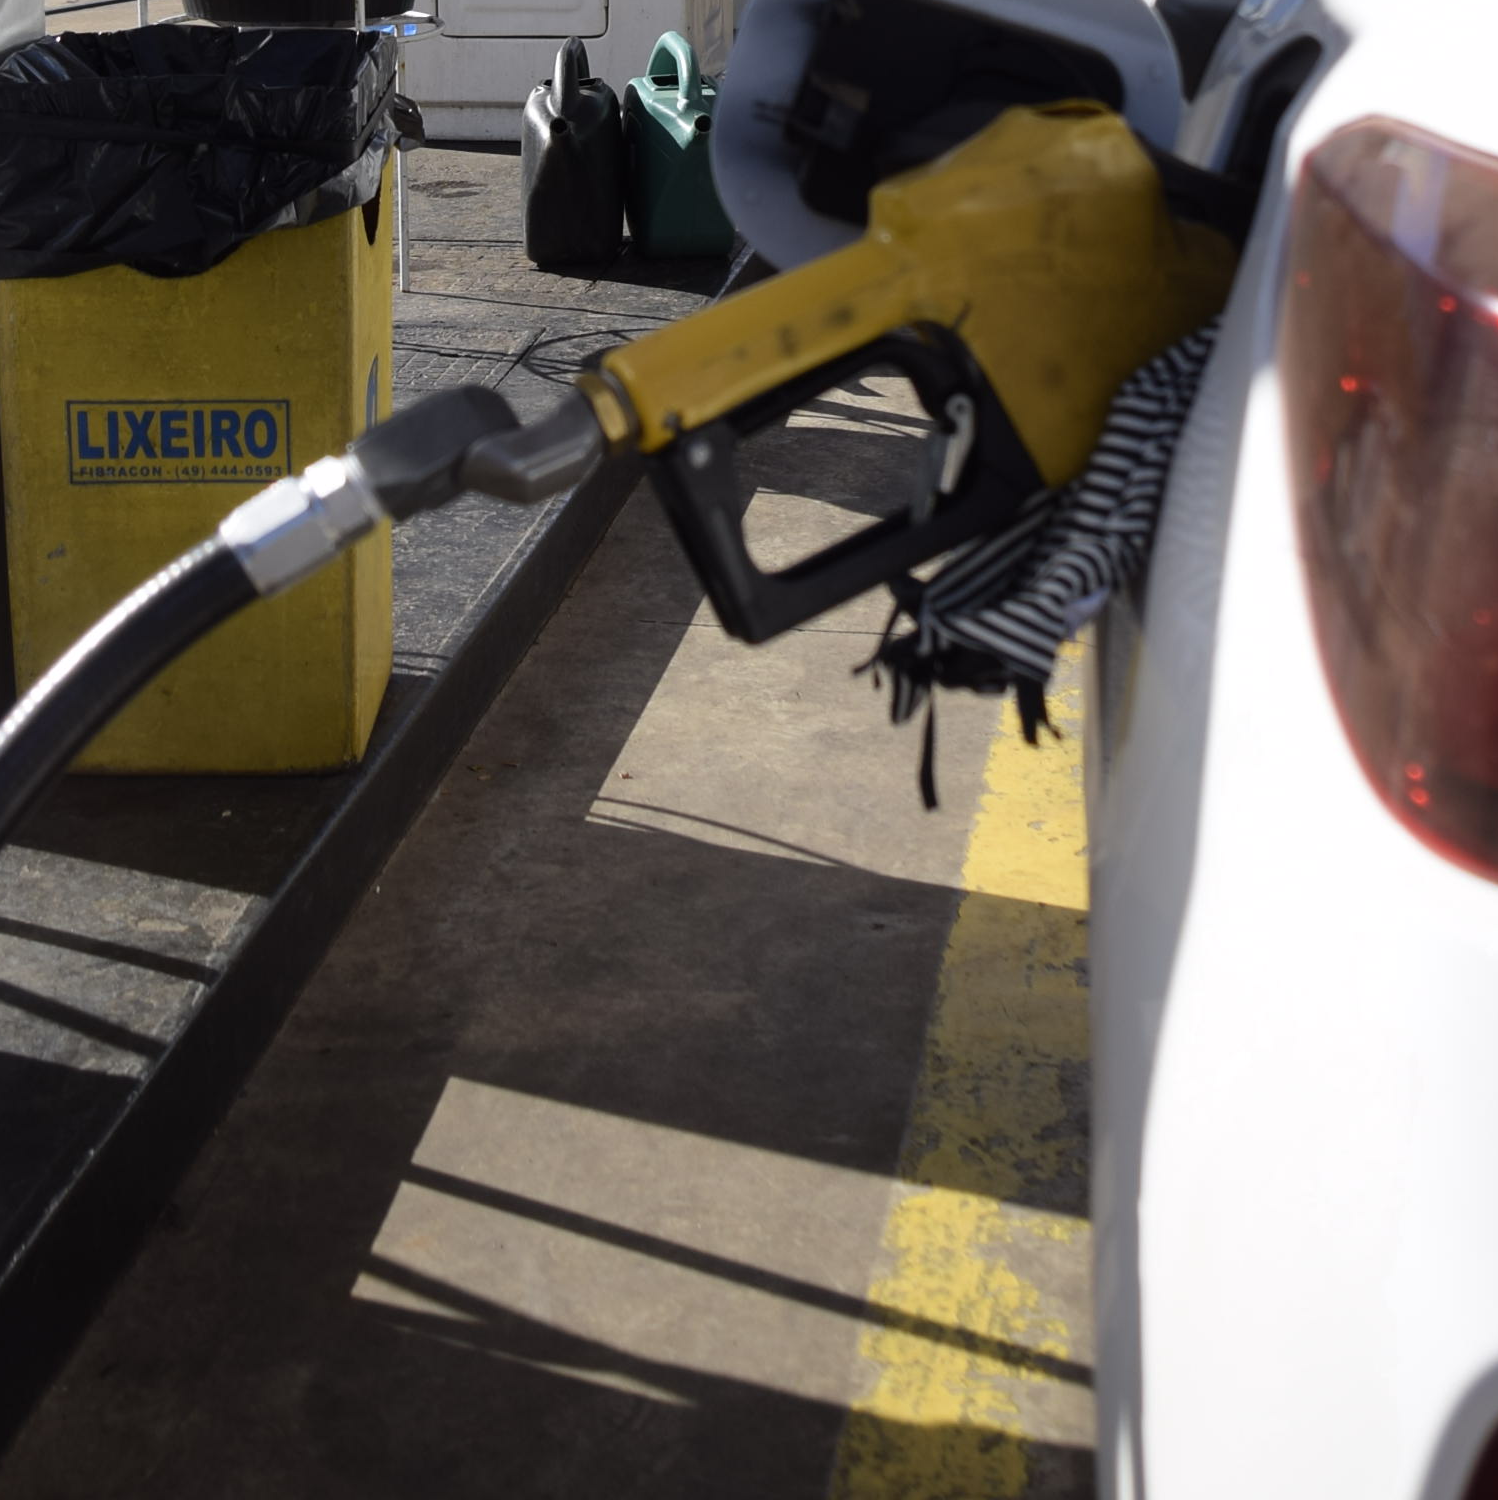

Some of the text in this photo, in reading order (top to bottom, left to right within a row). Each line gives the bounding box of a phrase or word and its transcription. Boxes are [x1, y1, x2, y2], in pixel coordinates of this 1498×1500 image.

[77, 409, 278, 460] LIXEIRO
[79, 465, 162, 477] FIBRACON
[174, 464, 206, 479] (49)
[211, 463, 283, 477] 444-0593
